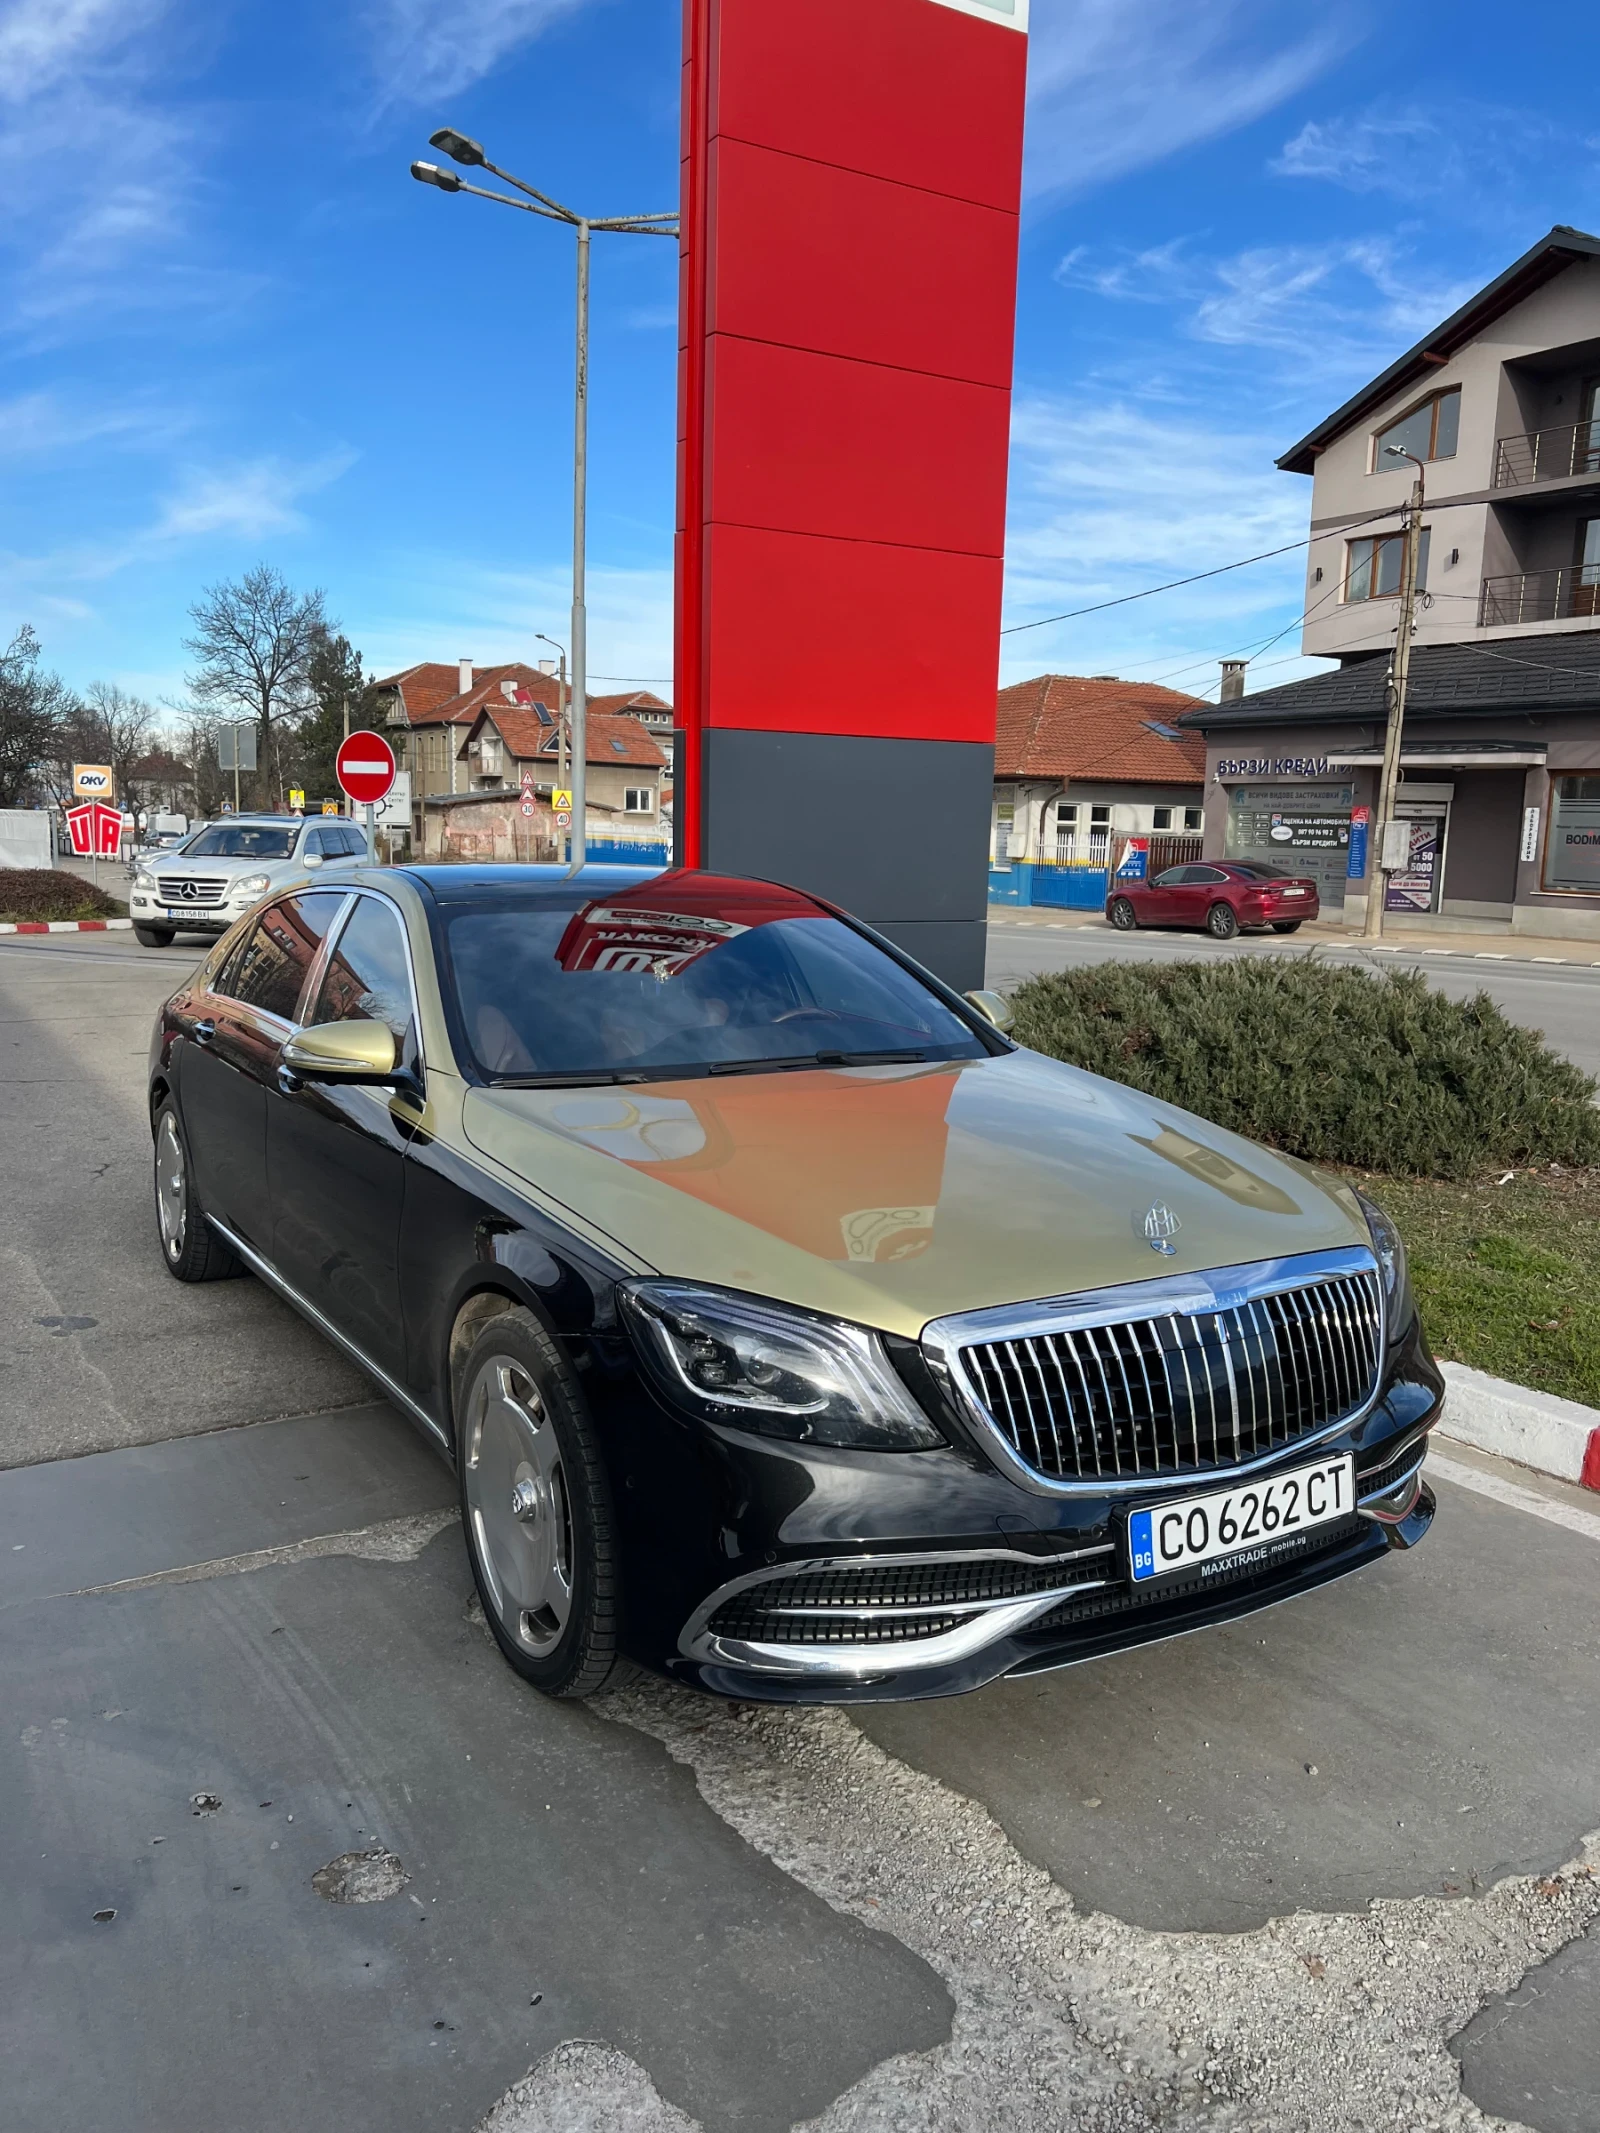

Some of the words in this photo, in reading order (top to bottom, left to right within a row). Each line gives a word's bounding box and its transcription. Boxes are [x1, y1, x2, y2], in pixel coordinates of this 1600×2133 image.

[1218, 759, 1272, 776] БЪРЗИ
[80, 776, 106, 785] DKV
[1248, 791, 1269, 799] ВСИЧИ
[1269, 791, 1294, 800] ВИДОВЕ
[1294, 791, 1339, 799] ЗАСТРАХОВКИ
[523, 804, 533, 814] 30
[558, 815, 568, 824] 40
[1282, 818, 1304, 826] ОЦЕНКА
[1422, 851, 1434, 861] 50
[1410, 863, 1432, 872] 5000
[1159, 1507, 1209, 1560] CO
[1218, 1480, 1300, 1545] 6262
[1307, 1463, 1346, 1516] CT
[1135, 1552, 1152, 1569] BG
